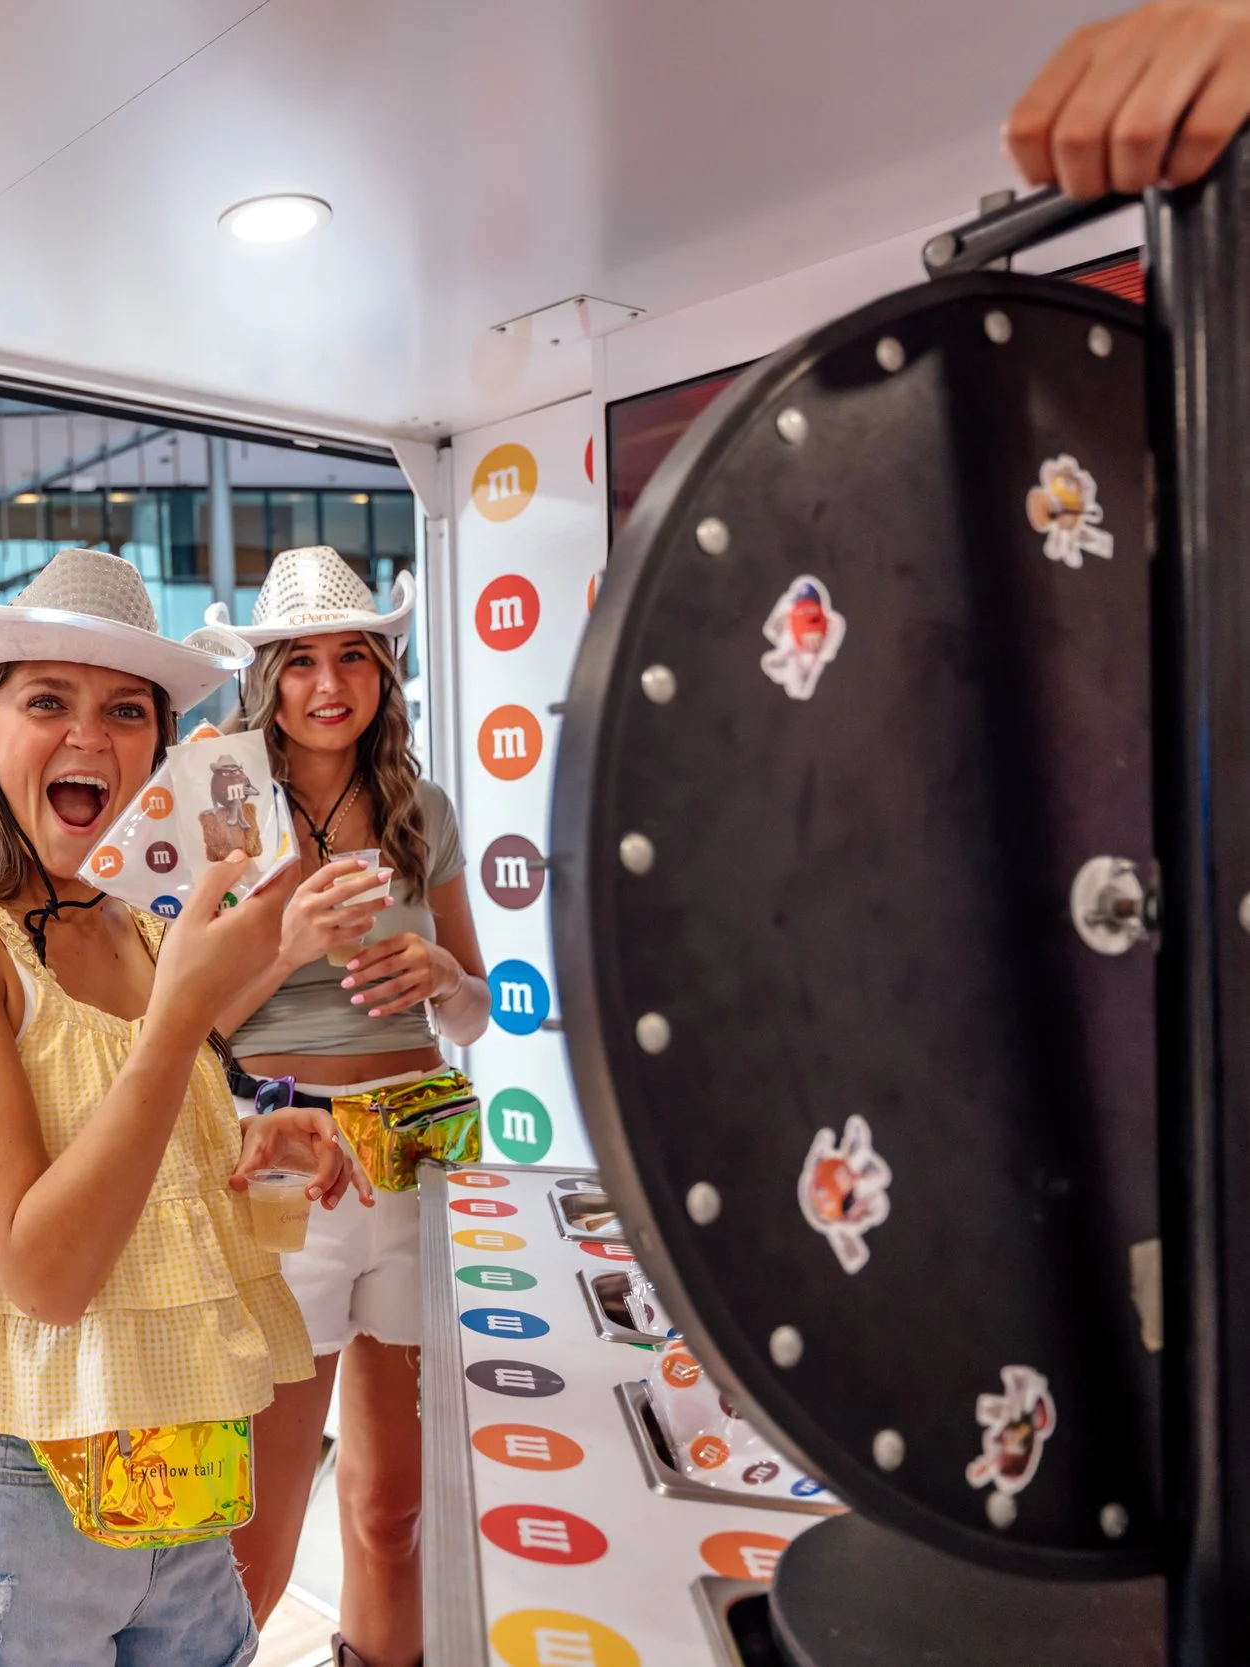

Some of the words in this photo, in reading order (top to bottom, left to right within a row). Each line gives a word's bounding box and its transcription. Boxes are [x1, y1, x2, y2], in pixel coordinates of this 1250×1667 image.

[487, 466, 522, 502] m
[489, 596, 524, 631] m
[492, 726, 527, 759] m
[226, 783, 246, 801] m
[152, 850, 171, 865] m
[495, 856, 530, 888] m
[157, 904, 176, 915] m
[500, 981, 534, 1014] m
[502, 1108, 537, 1144] m
[141, 1463, 188, 1482] yellow
[194, 1462, 214, 1477] tail
